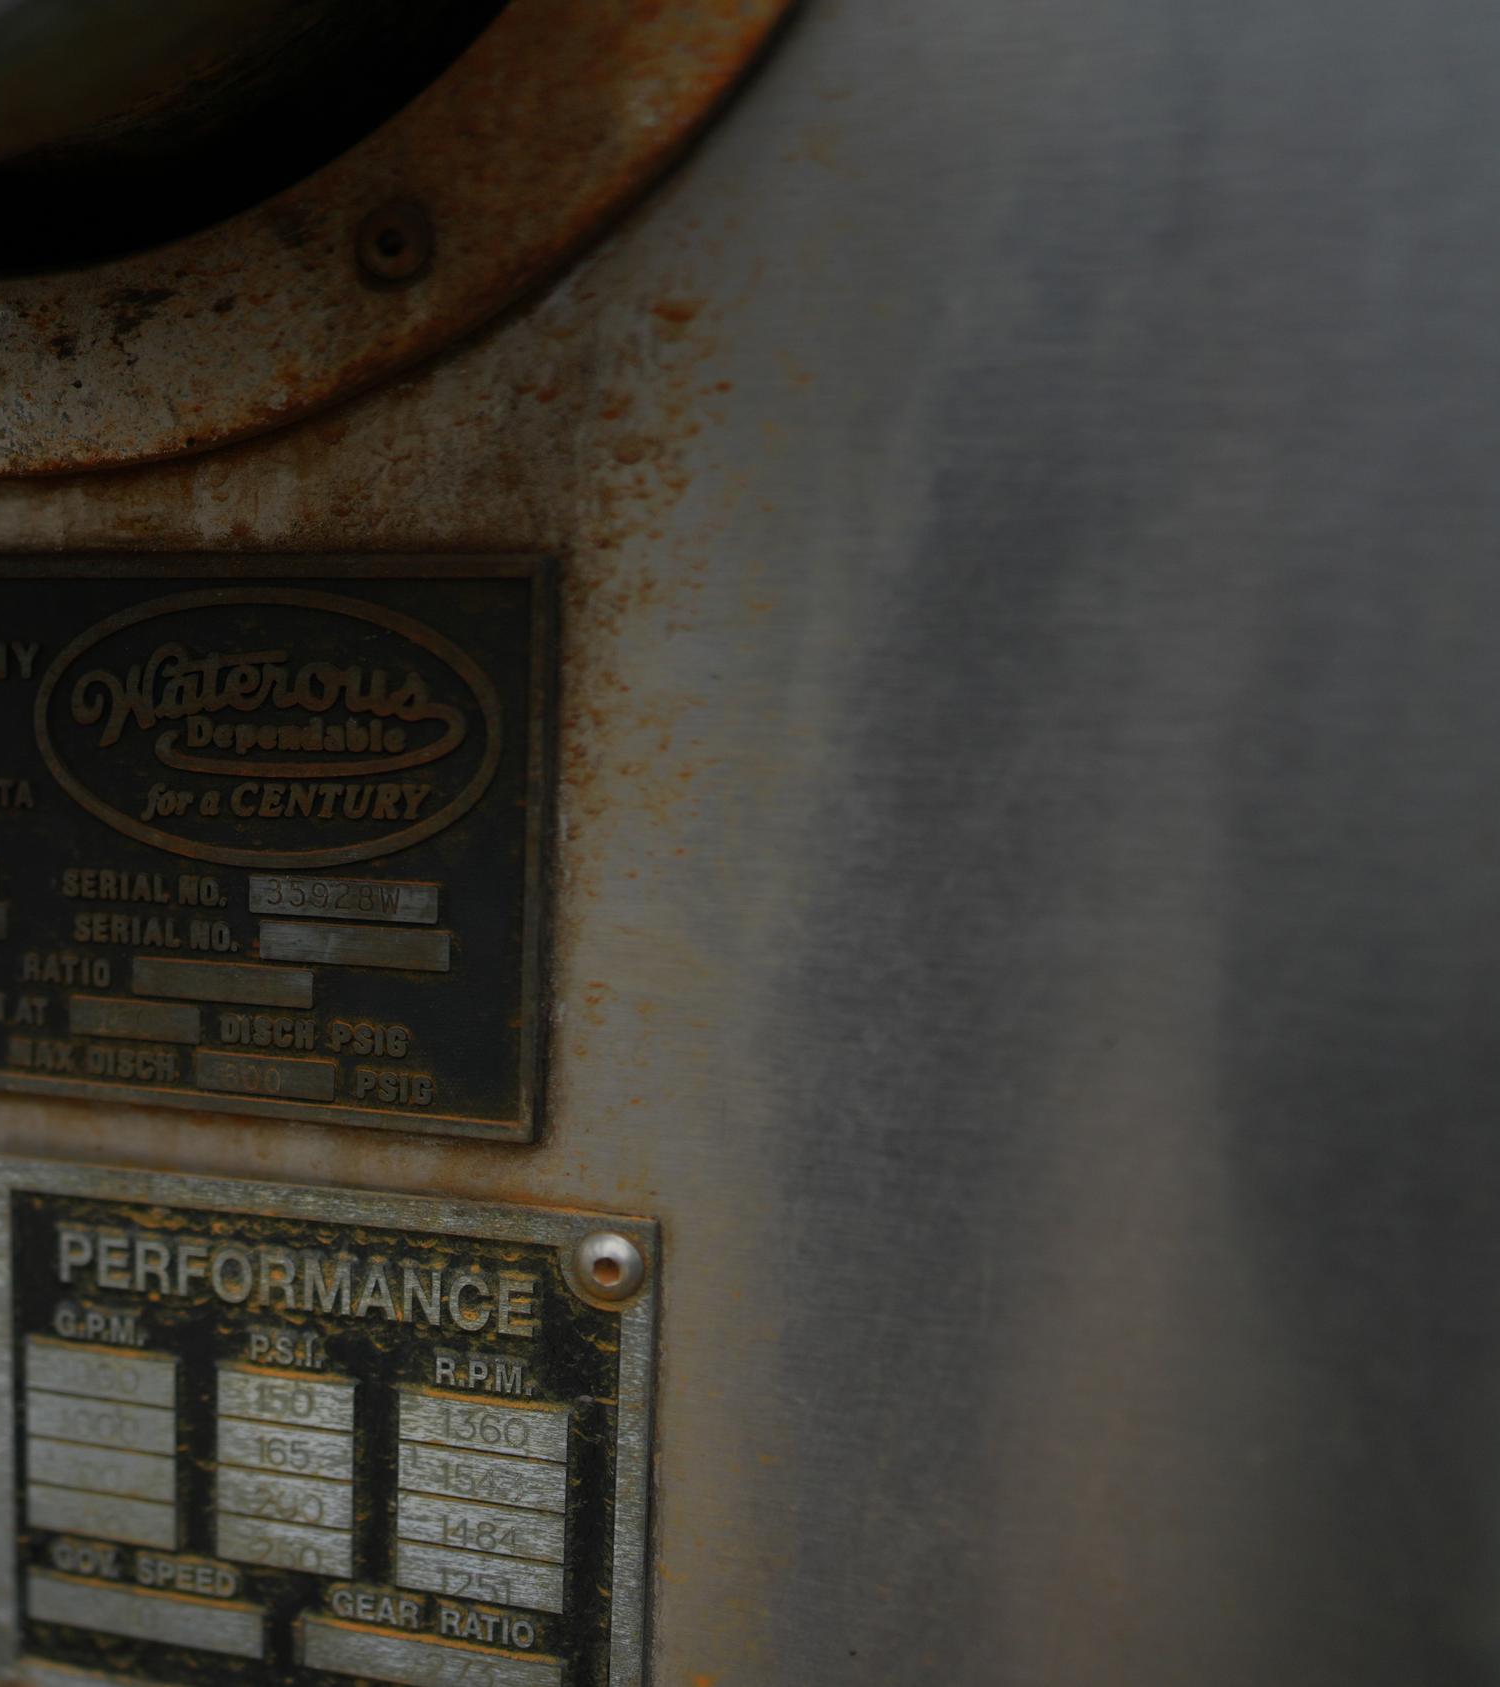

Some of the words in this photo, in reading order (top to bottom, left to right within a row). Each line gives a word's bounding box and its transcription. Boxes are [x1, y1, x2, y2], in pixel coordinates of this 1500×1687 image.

[71, 642, 468, 748] Waterous
[186, 716, 408, 755] Dependable
[141, 783, 193, 821] for
[201, 794, 219, 815] a
[229, 783, 432, 820] CENTURY
[61, 869, 170, 905] SERIAL
[179, 874, 228, 907] NO.
[266, 878, 402, 916] 35928W
[73, 913, 180, 950] SERIAL
[190, 919, 240, 953] NO.
[22, 951, 112, 989] RATIO
[14, 997, 50, 1026] AT
[220, 1012, 317, 1052] DISCH
[330, 1020, 412, 1059] PSIG
[356, 1069, 434, 1106] PSIG
[56, 1224, 536, 1337] PERFORMANCE
[54, 1309, 146, 1346] G.P.M.
[248, 1330, 325, 1369] P.S.I.
[434, 1356, 534, 1396] R.P.M.
[255, 1382, 314, 1418] 150
[438, 1406, 529, 1449] 1360
[255, 1435, 311, 1470] 165
[440, 1514, 518, 1553] 1484
[137, 1556, 238, 1597] SPEED
[332, 1590, 419, 1628] GEAR
[441, 1609, 535, 1649] RATIO
